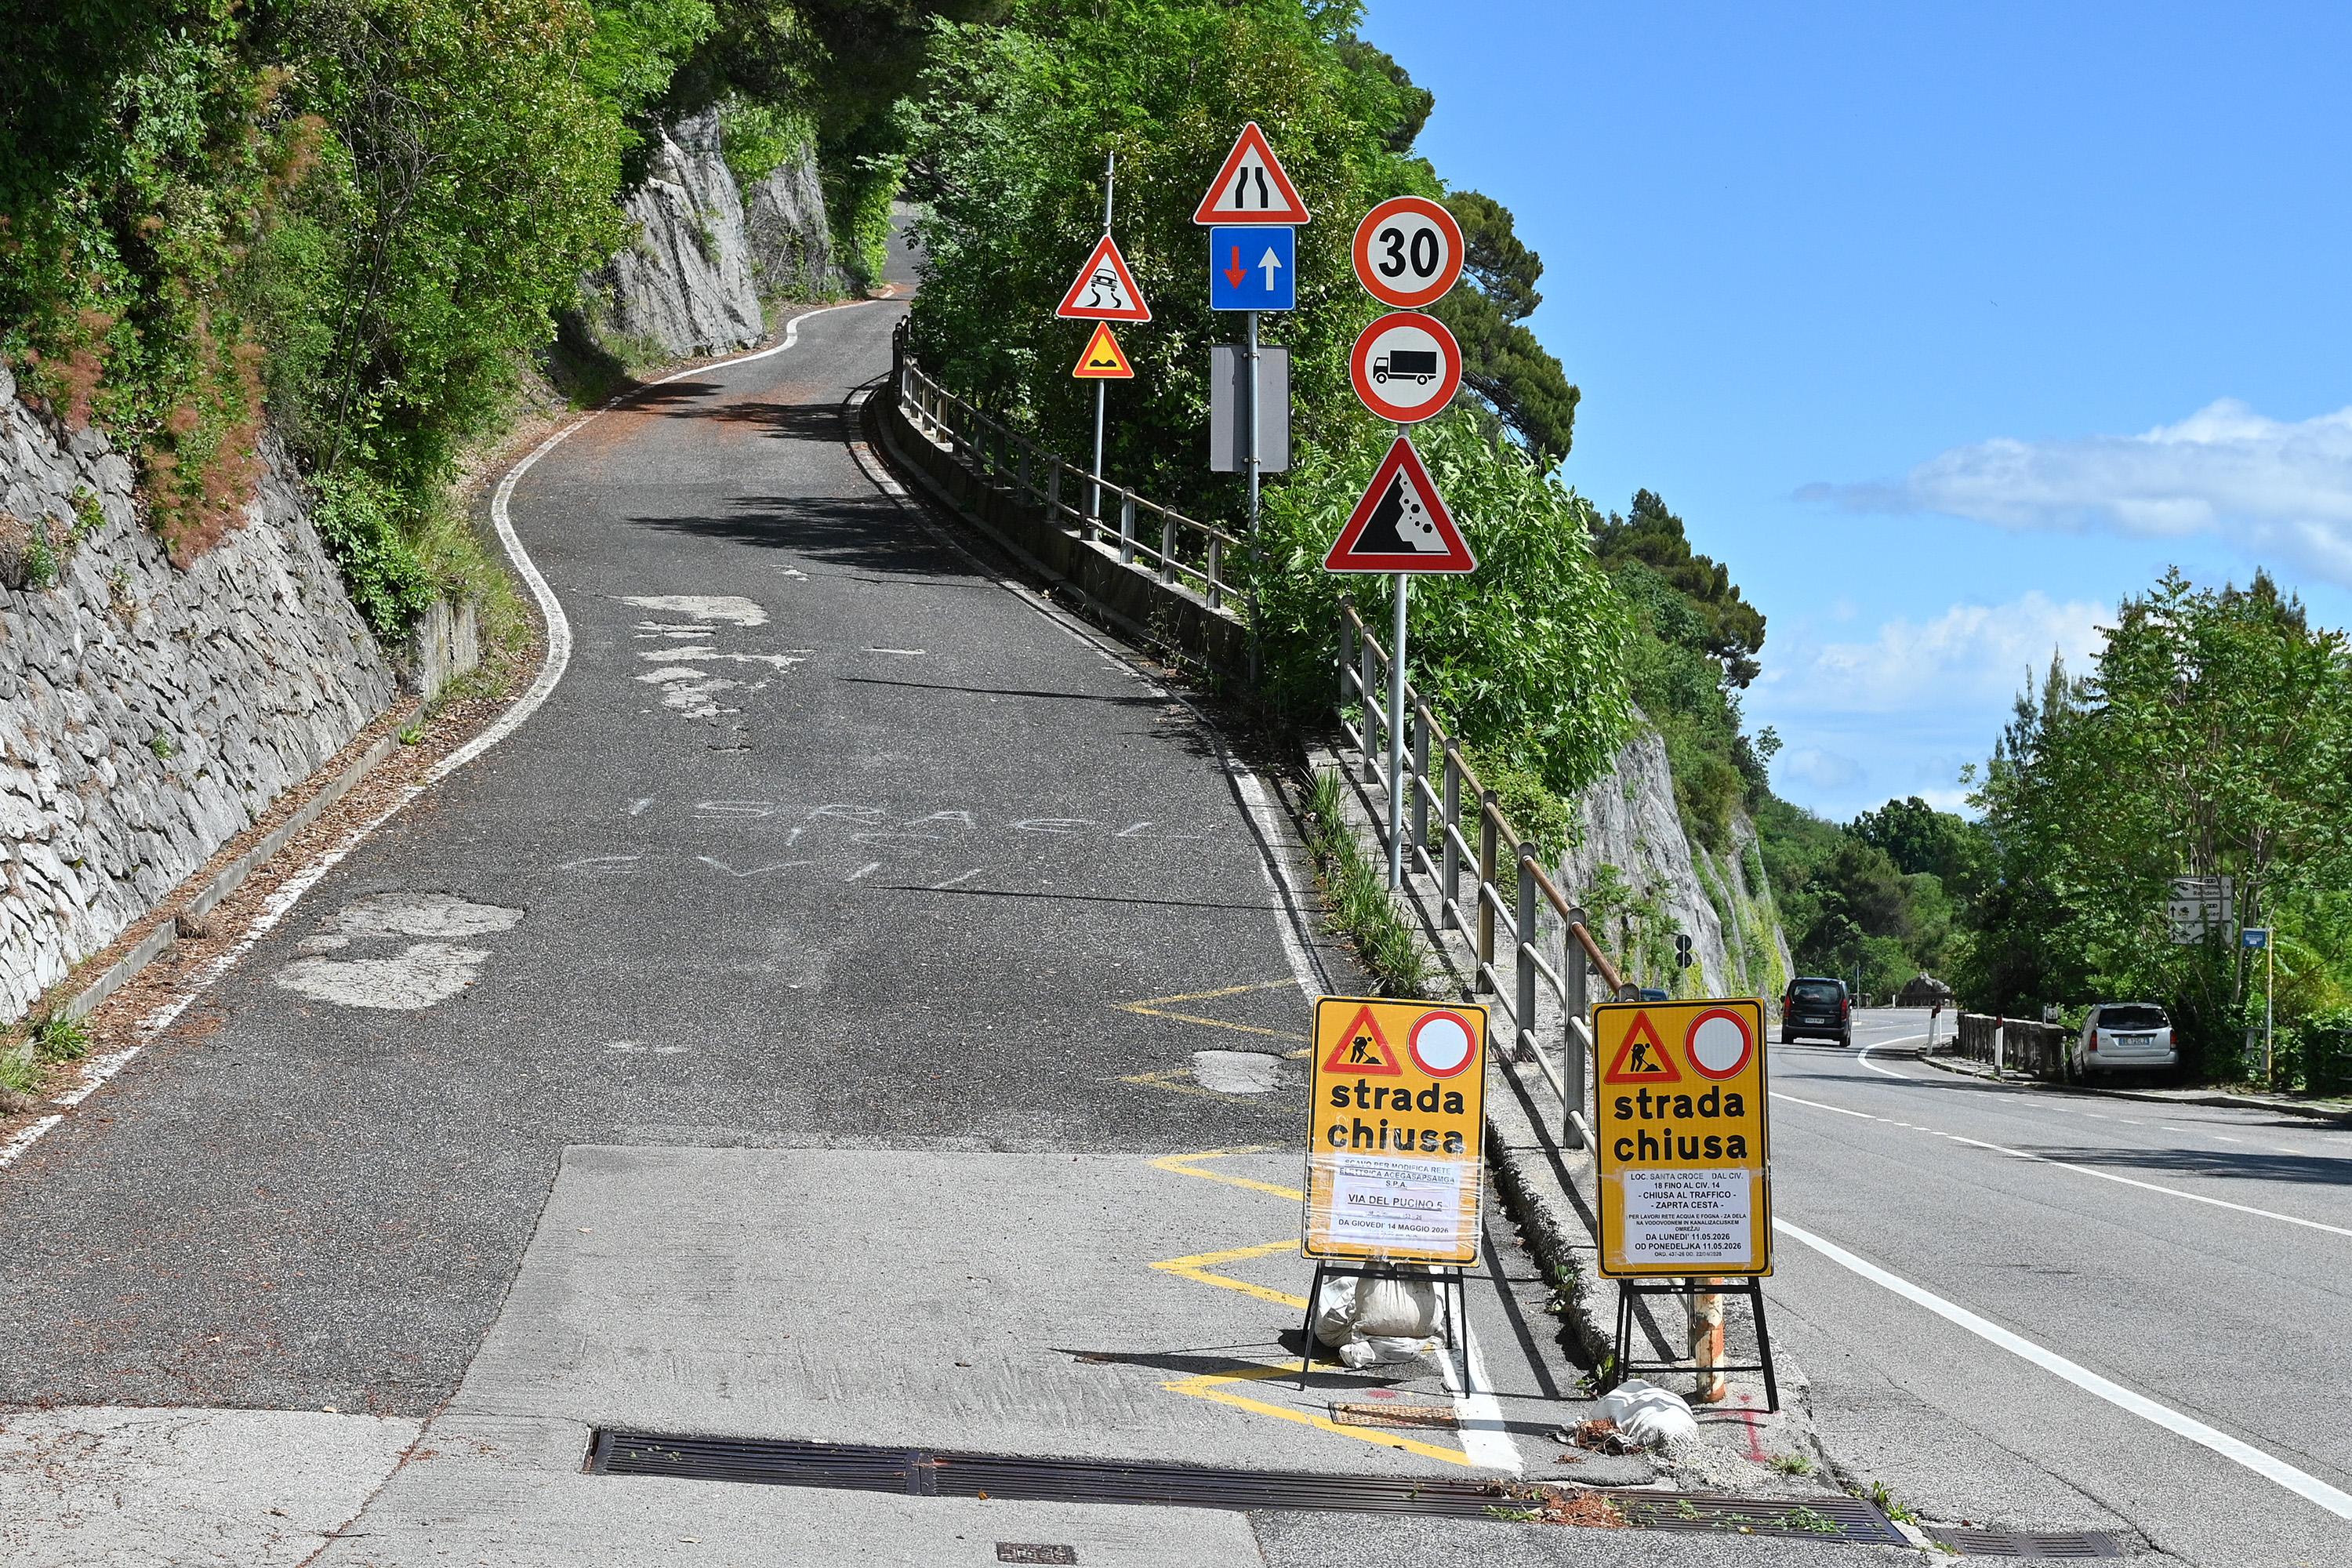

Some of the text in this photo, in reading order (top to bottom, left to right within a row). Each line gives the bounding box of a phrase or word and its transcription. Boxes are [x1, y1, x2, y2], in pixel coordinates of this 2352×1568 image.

[1378, 227, 1439, 278] 30
[630, 797, 1200, 839] ISRAEL
[1330, 1079, 1465, 1115] strada
[1613, 1085, 1745, 1120] strada
[1327, 1118, 1465, 1154] chiusa
[1613, 1127, 1748, 1162] chiusa
[1392, 1163, 1428, 1172] MODIFICA
[1431, 1167, 1450, 1175] RETE
[1348, 1193, 1365, 1203] VIA
[1369, 1196, 1389, 1206] DEL
[1392, 1197, 1434, 1209] PUCINO
[1398, 1224, 1429, 1232] MAGGIO
